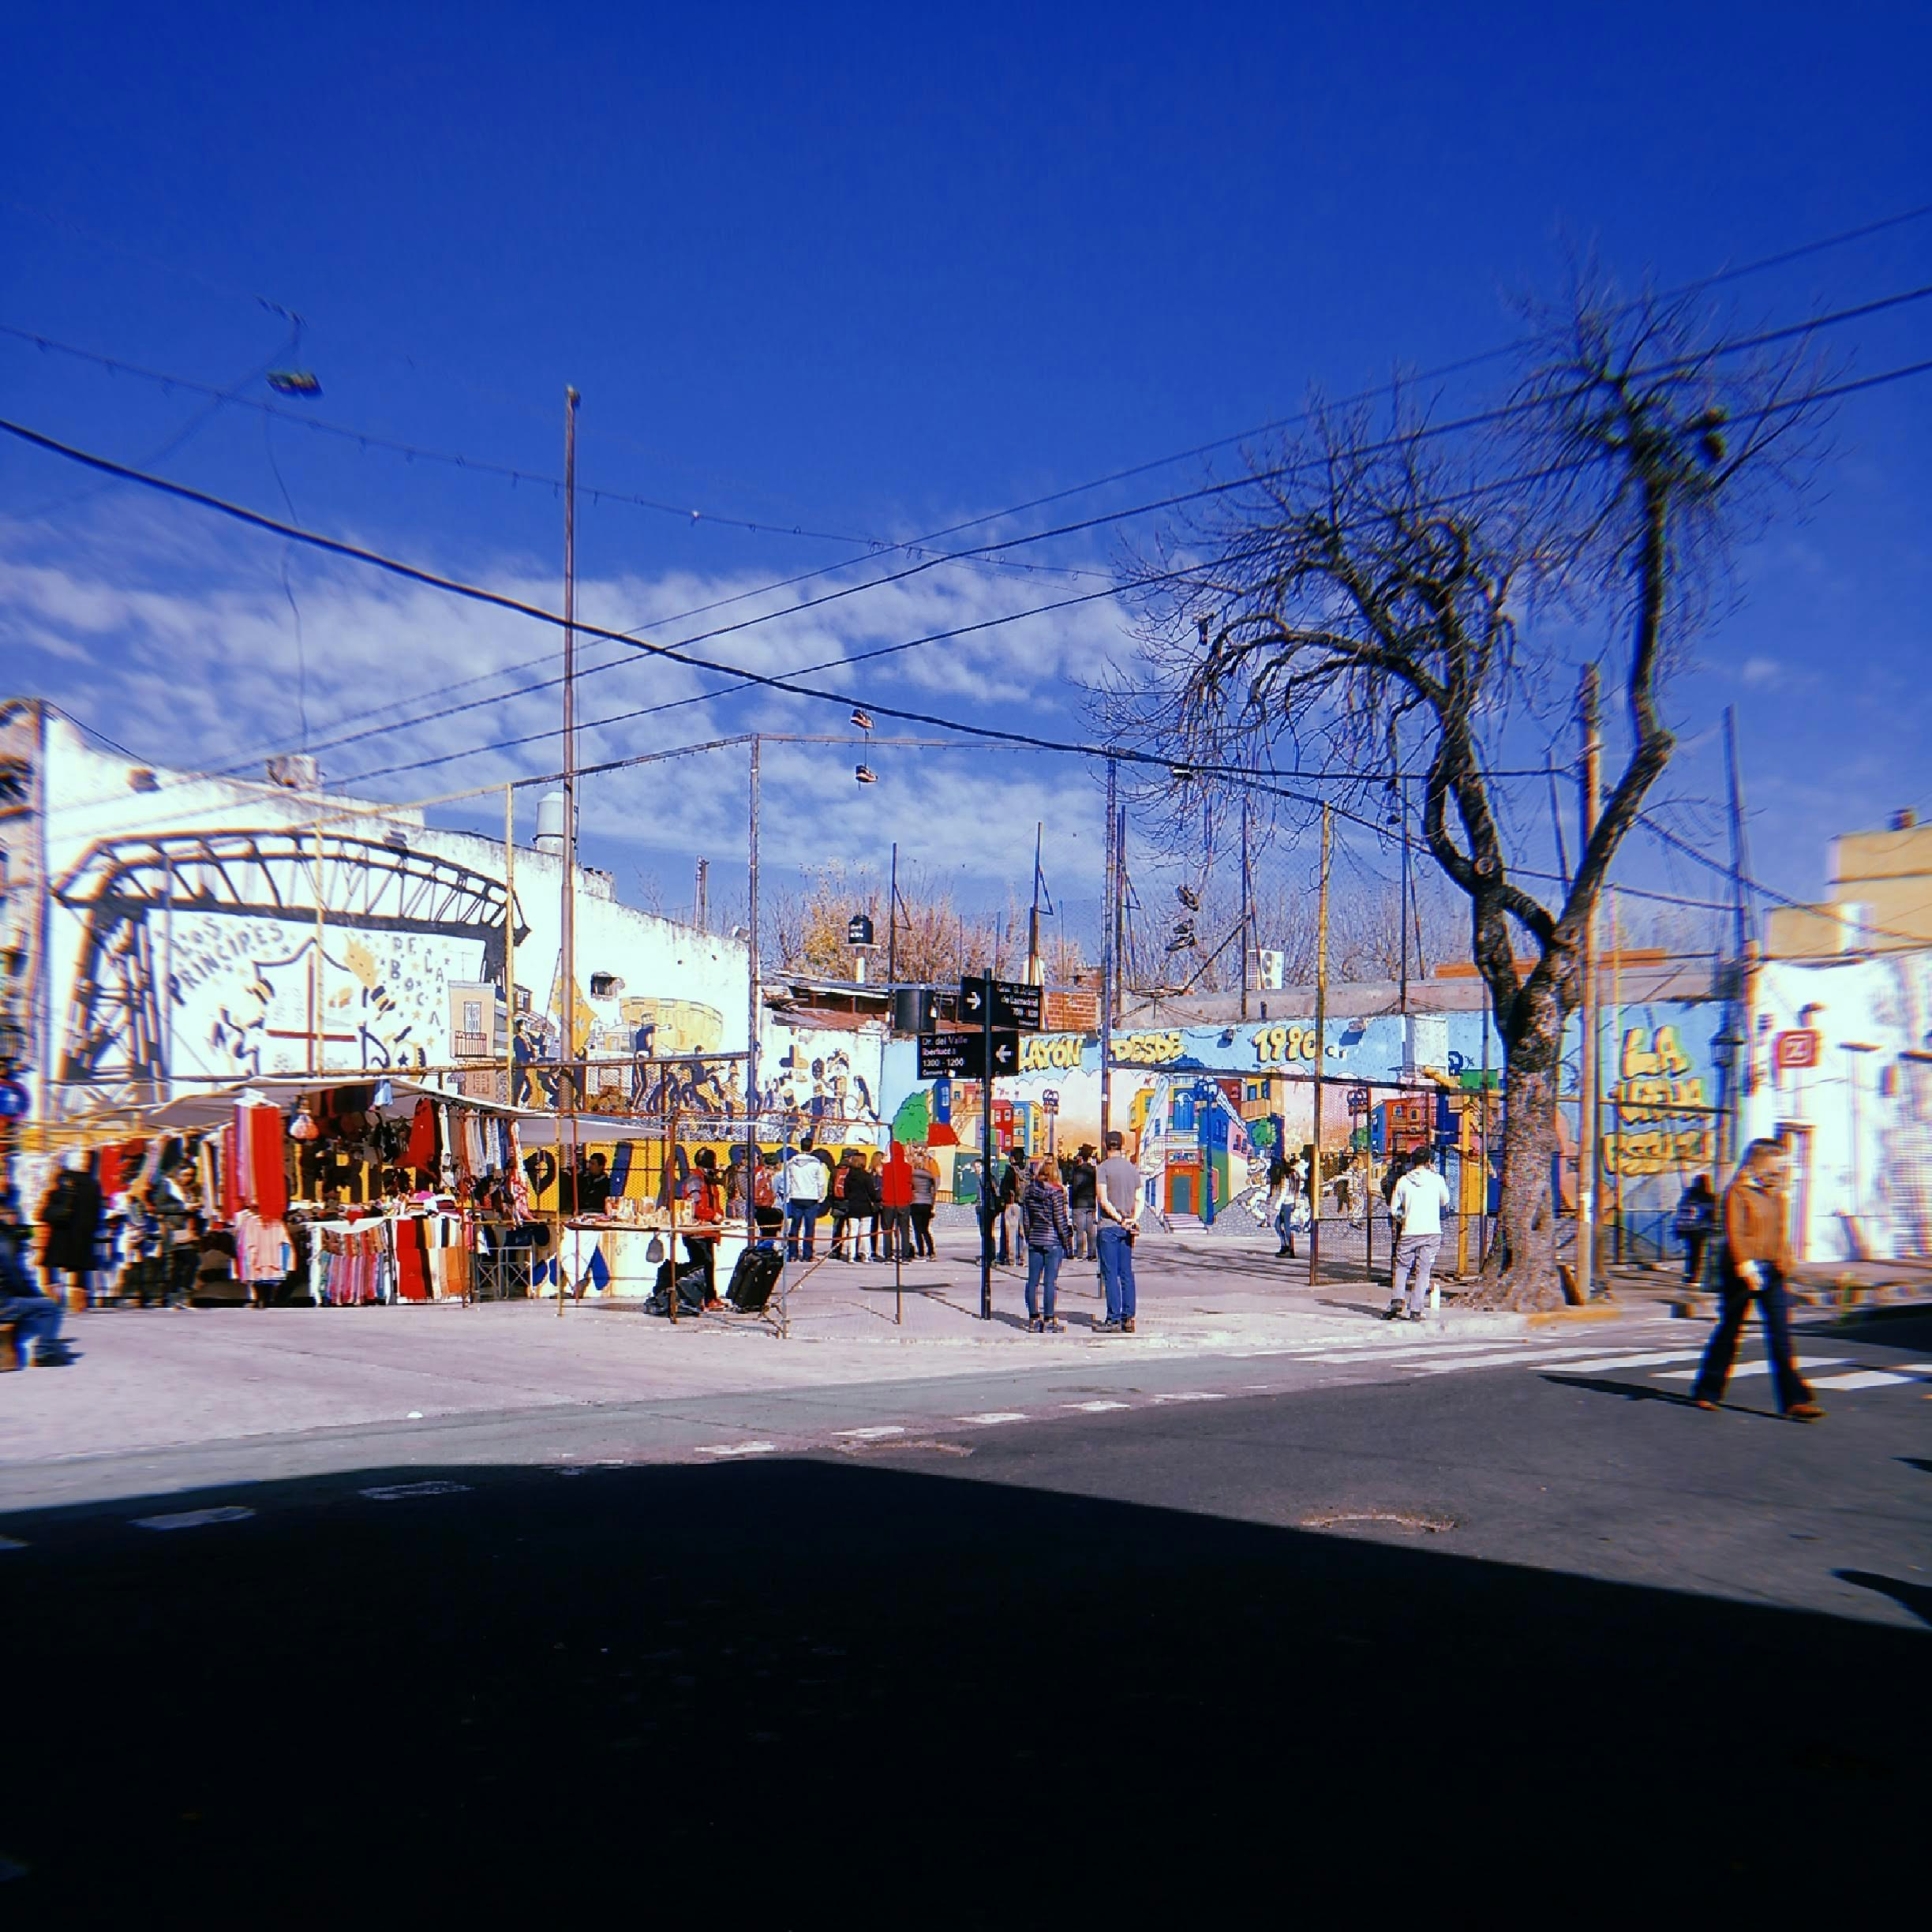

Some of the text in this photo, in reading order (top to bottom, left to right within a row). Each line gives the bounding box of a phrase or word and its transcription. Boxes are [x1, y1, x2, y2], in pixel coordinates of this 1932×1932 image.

[393, 936, 417, 956] DE
[935, 1036, 947, 1046] del
[1108, 1031, 1186, 1063] DESDE
[1623, 1024, 1691, 1080] LA
